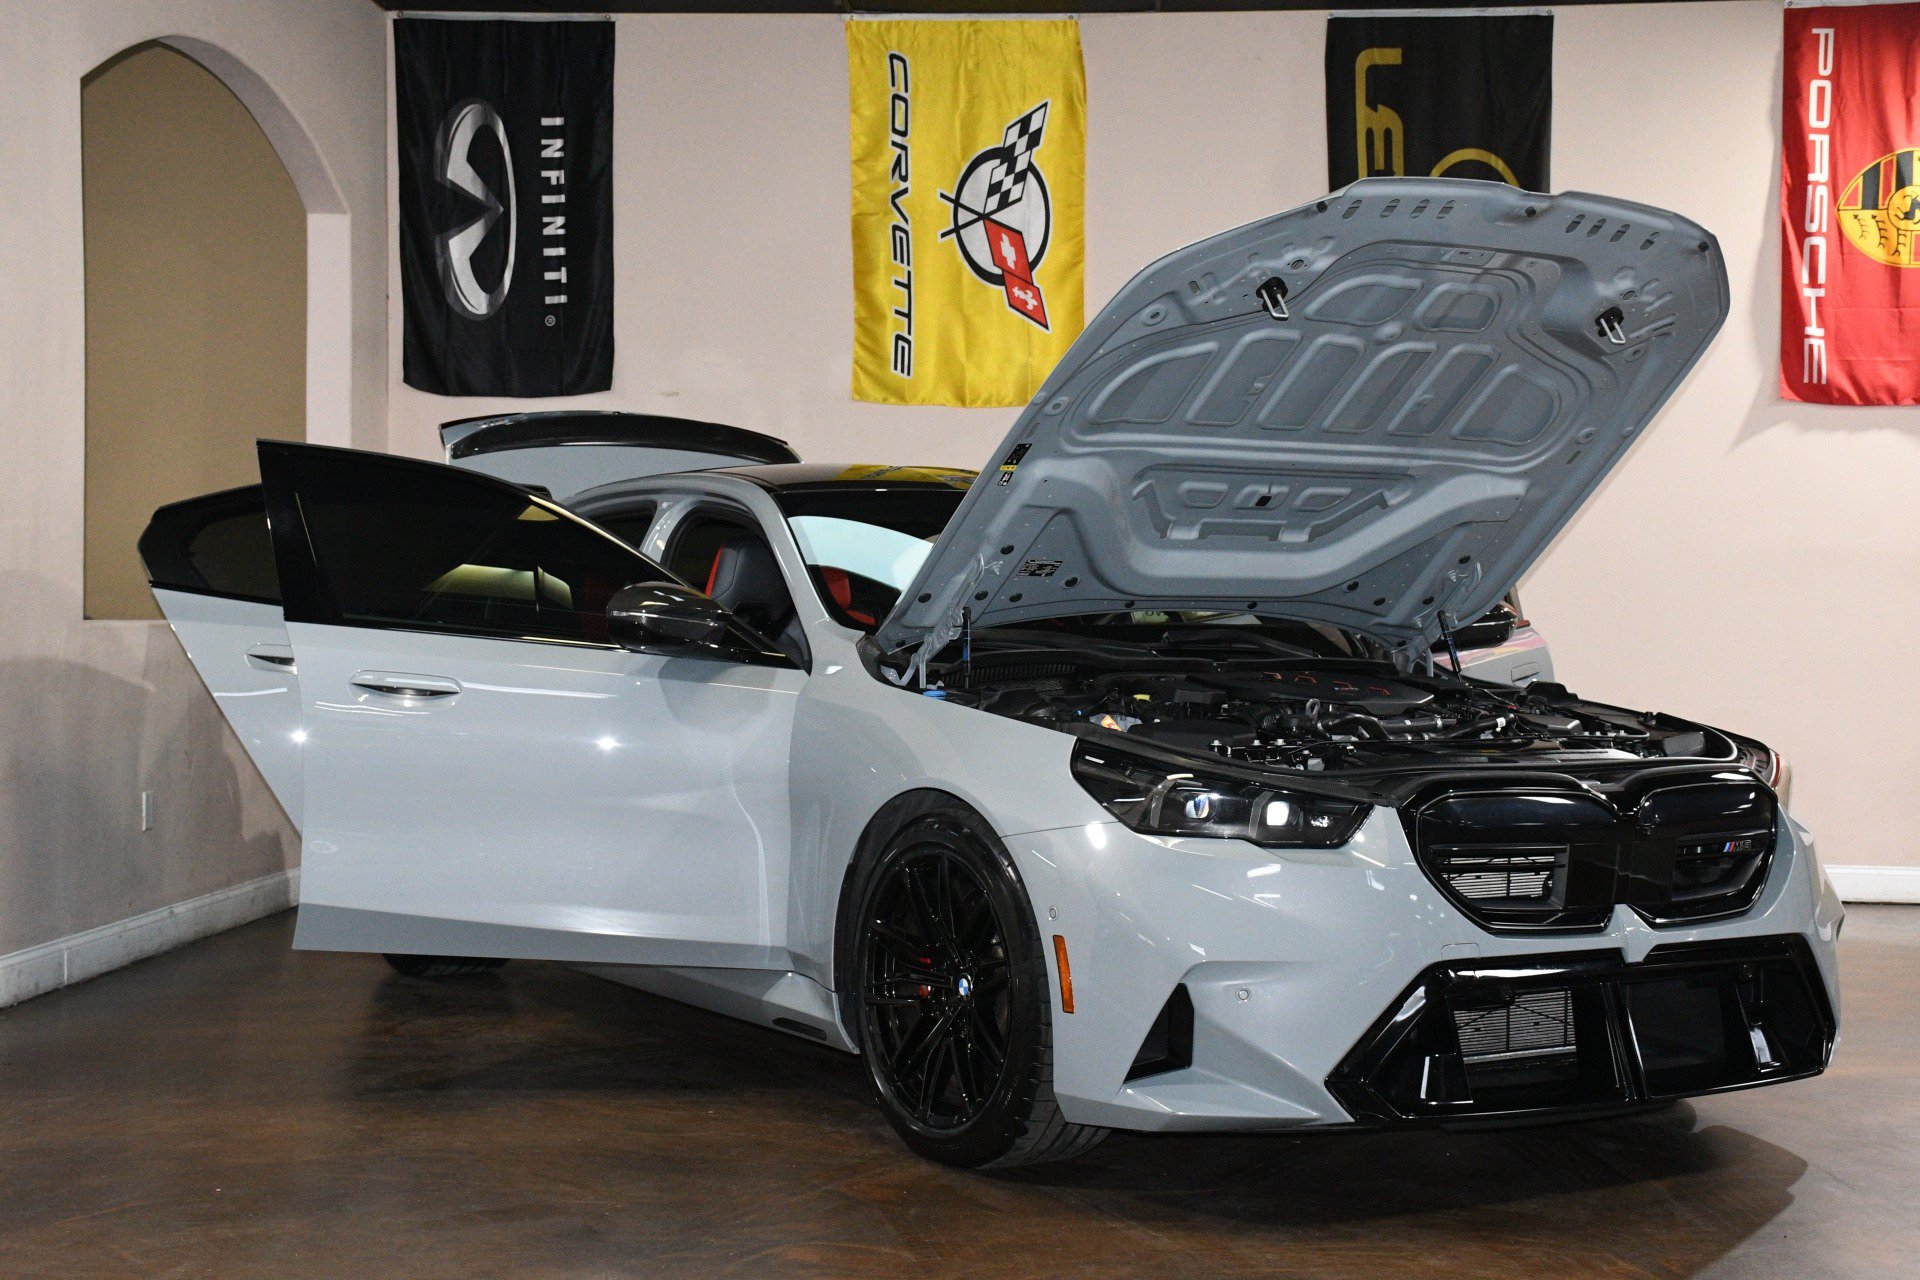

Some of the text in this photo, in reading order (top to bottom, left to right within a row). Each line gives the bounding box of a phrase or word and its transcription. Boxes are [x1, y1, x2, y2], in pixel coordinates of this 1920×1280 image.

[541, 116, 568, 305] INFINITI
[888, 51, 912, 378] CORVETTE
[1802, 27, 1835, 385] PORSCHE
